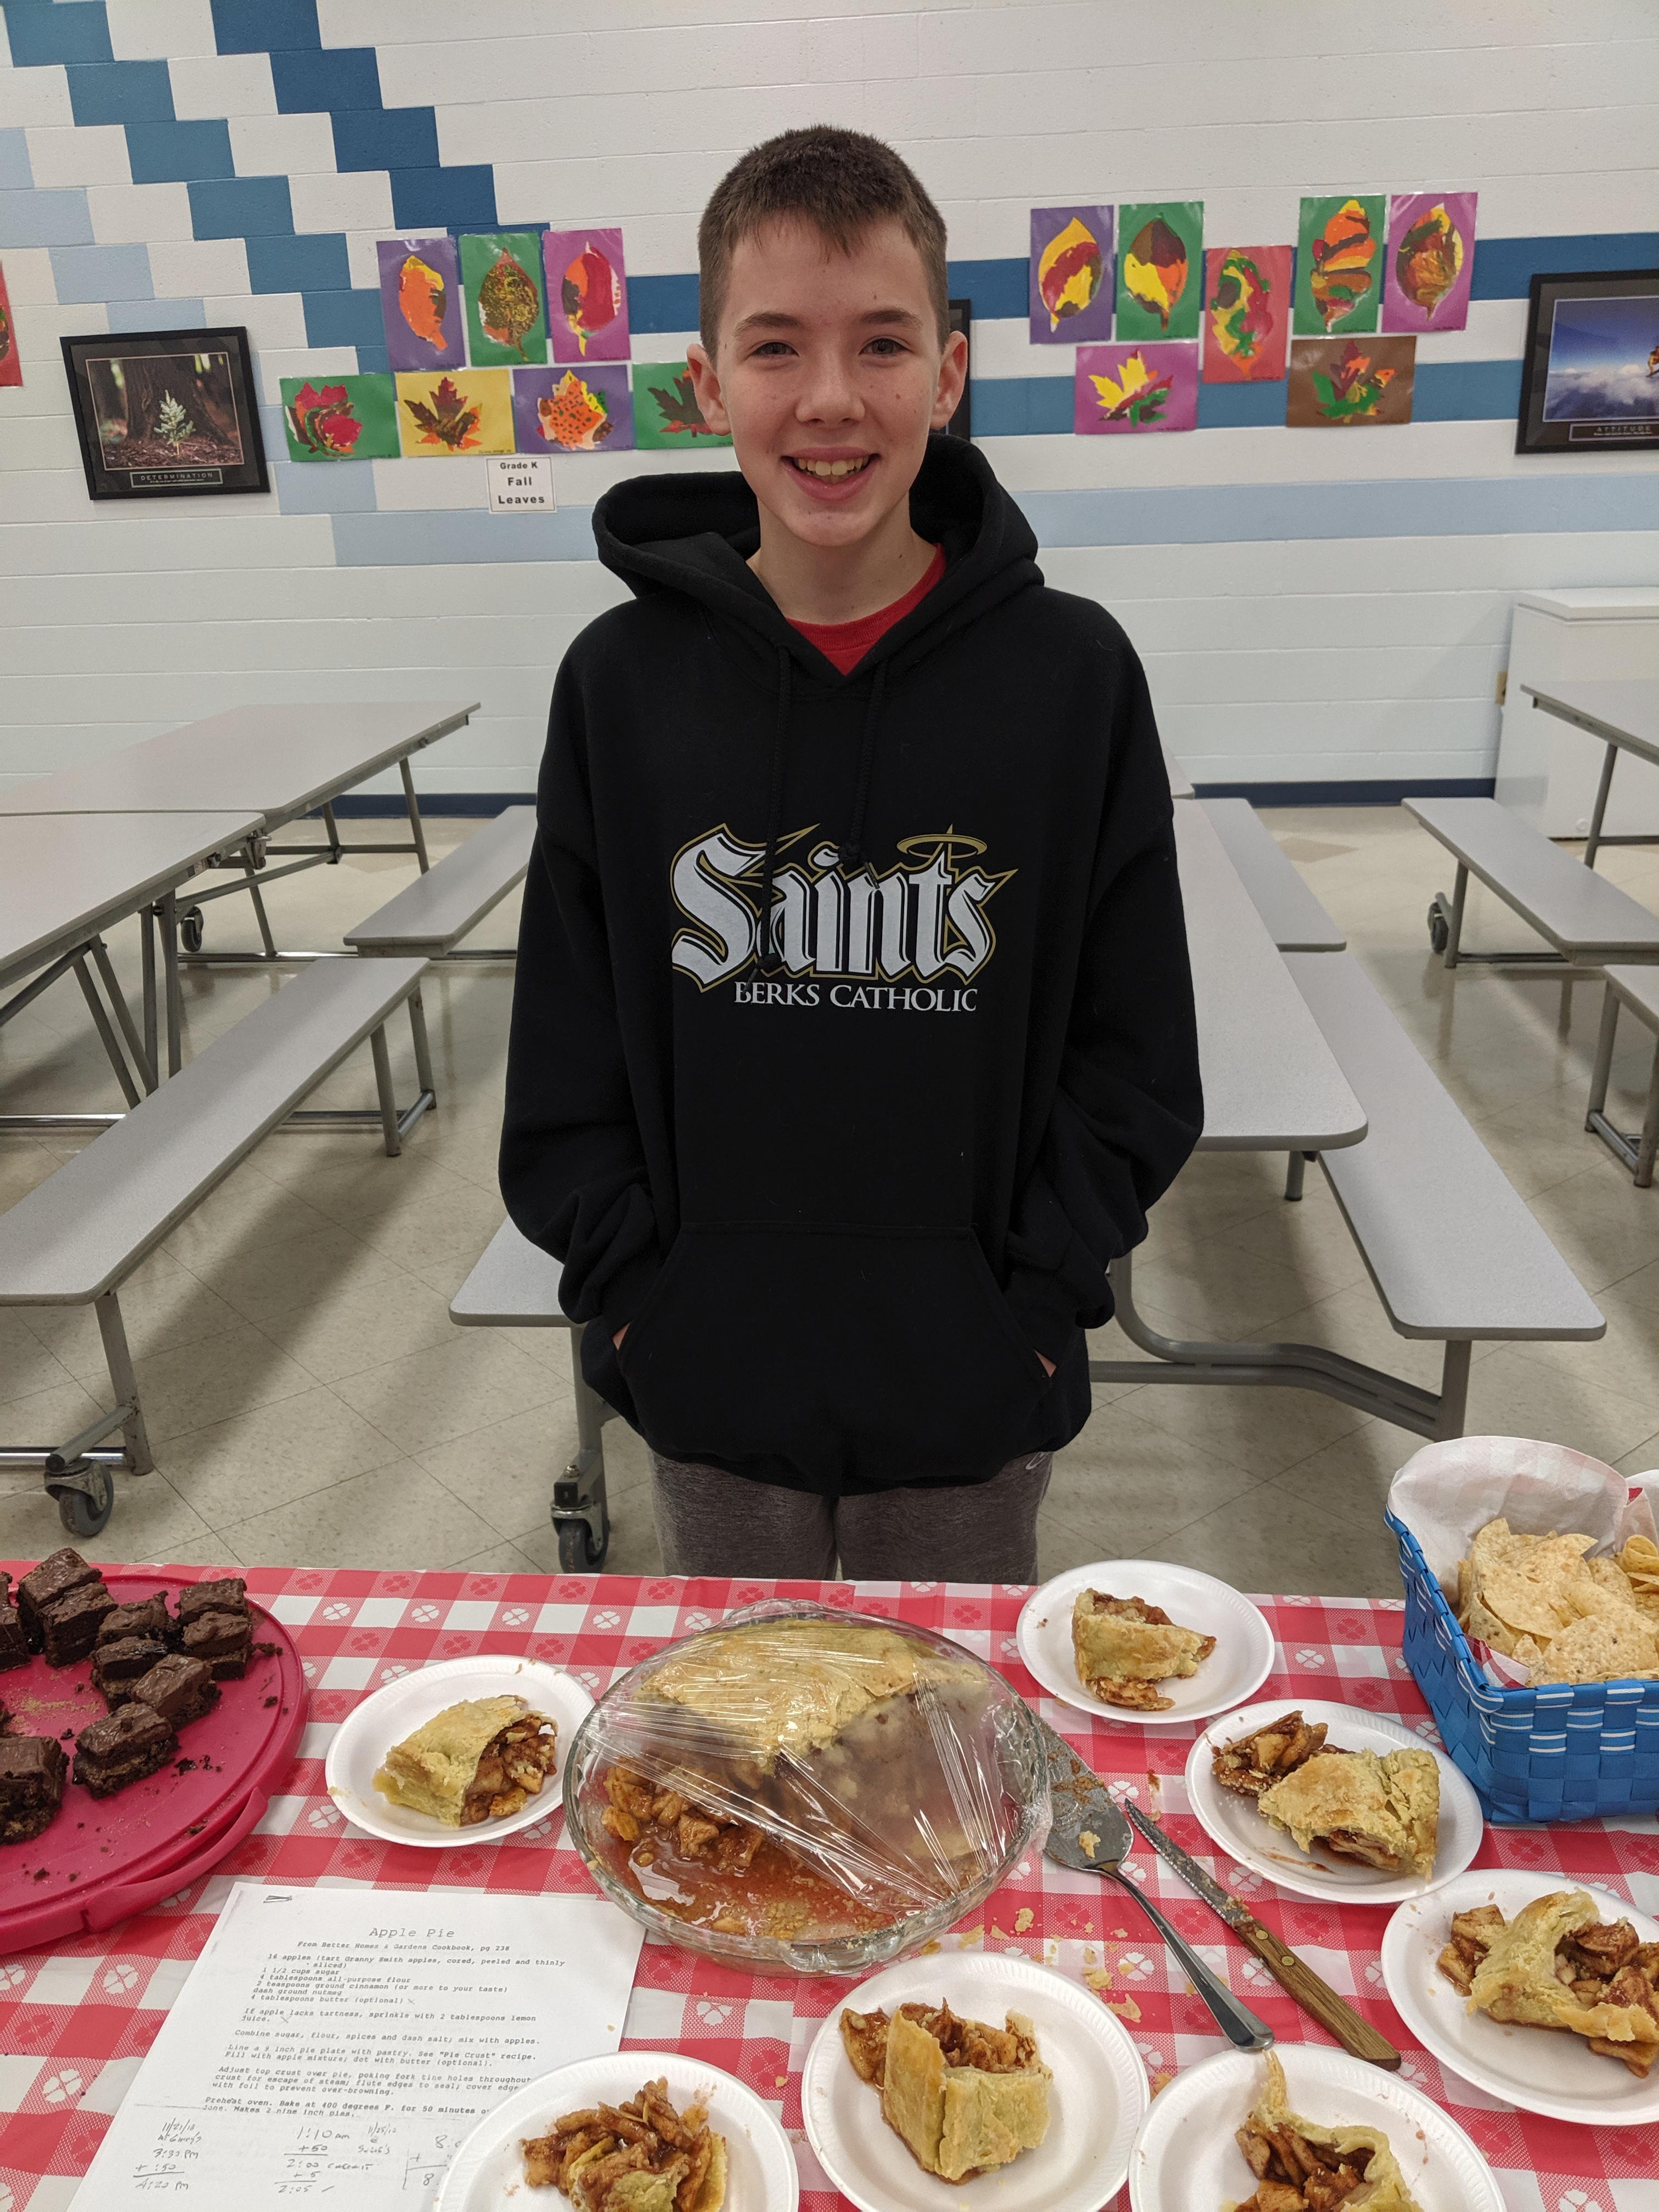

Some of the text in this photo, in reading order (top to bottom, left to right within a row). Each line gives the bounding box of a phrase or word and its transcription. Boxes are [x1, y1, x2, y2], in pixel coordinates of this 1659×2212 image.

[140, 473, 213, 481] DETERMINATION
[507, 476, 532, 486] Fall
[498, 495, 544, 504] Leaves
[670, 823, 1018, 992] Saints
[733, 981, 978, 1012] BERKS CATHOLIC
[369, 1928, 455, 1939] Apple Pie
[269, 1974, 323, 1983] tablespoons
[437, 2058, 492, 2067] (optional).
[255, 2067, 271, 2076] top
[387, 2080, 413, 2089] edges
[321, 2087, 394, 2096] over-browning.
[342, 2102, 380, 2111] degrees
